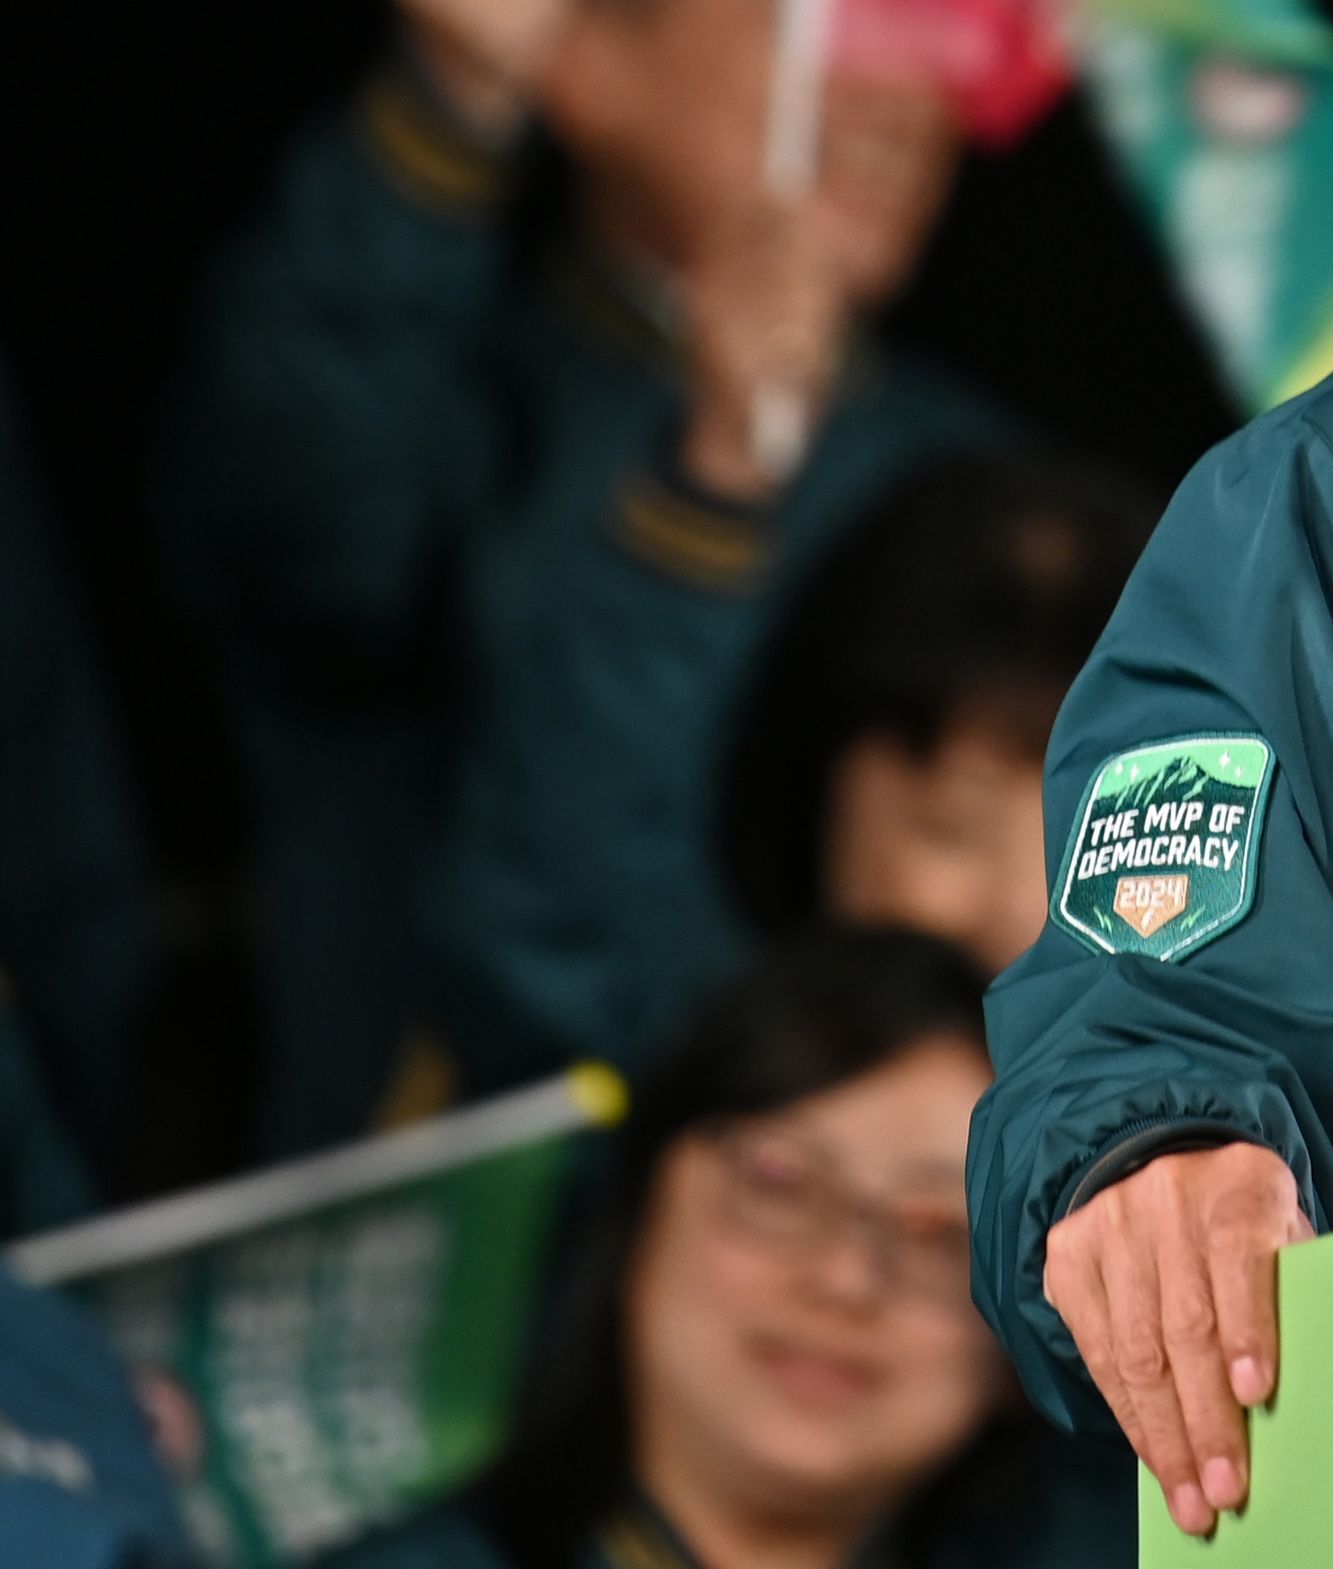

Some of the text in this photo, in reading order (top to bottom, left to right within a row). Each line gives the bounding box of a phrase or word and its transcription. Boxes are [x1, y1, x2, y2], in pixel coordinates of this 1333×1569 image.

[1090, 801, 1245, 847] THE MVP OF
[1077, 834, 1239, 881] DEMOCRACY
[1119, 880, 1185, 909] 2024
